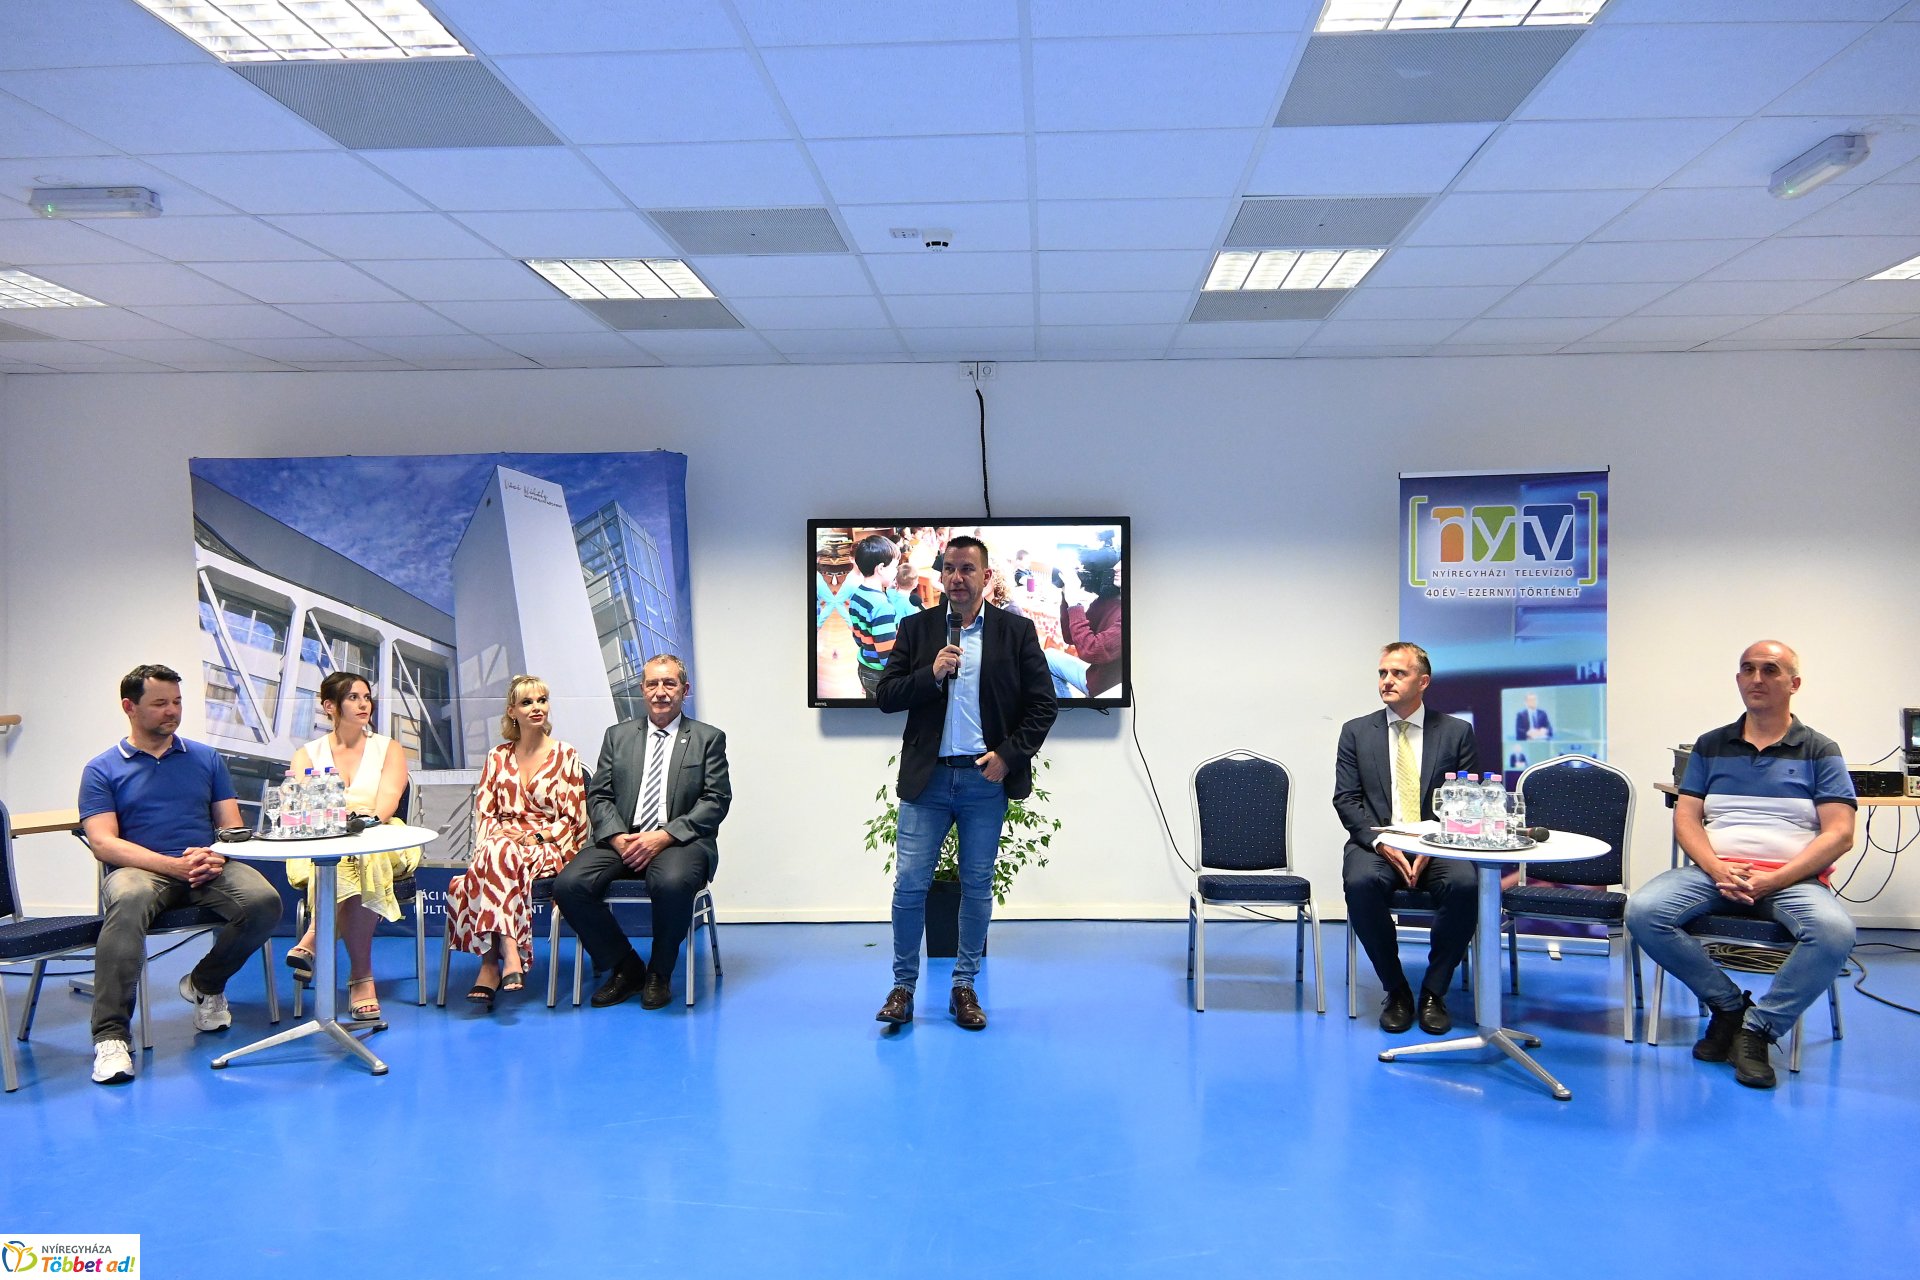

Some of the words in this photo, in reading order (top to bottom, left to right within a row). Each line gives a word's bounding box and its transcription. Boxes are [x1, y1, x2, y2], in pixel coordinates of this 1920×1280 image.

[1432, 568, 1506, 578] NYÍREGYHÁZI
[1514, 567, 1574, 577] TELEVÍZIÓ
[1468, 588, 1516, 597] EZERNYI
[1520, 586, 1581, 597] TÖRTÉNET
[421, 888, 439, 901] ÁCI
